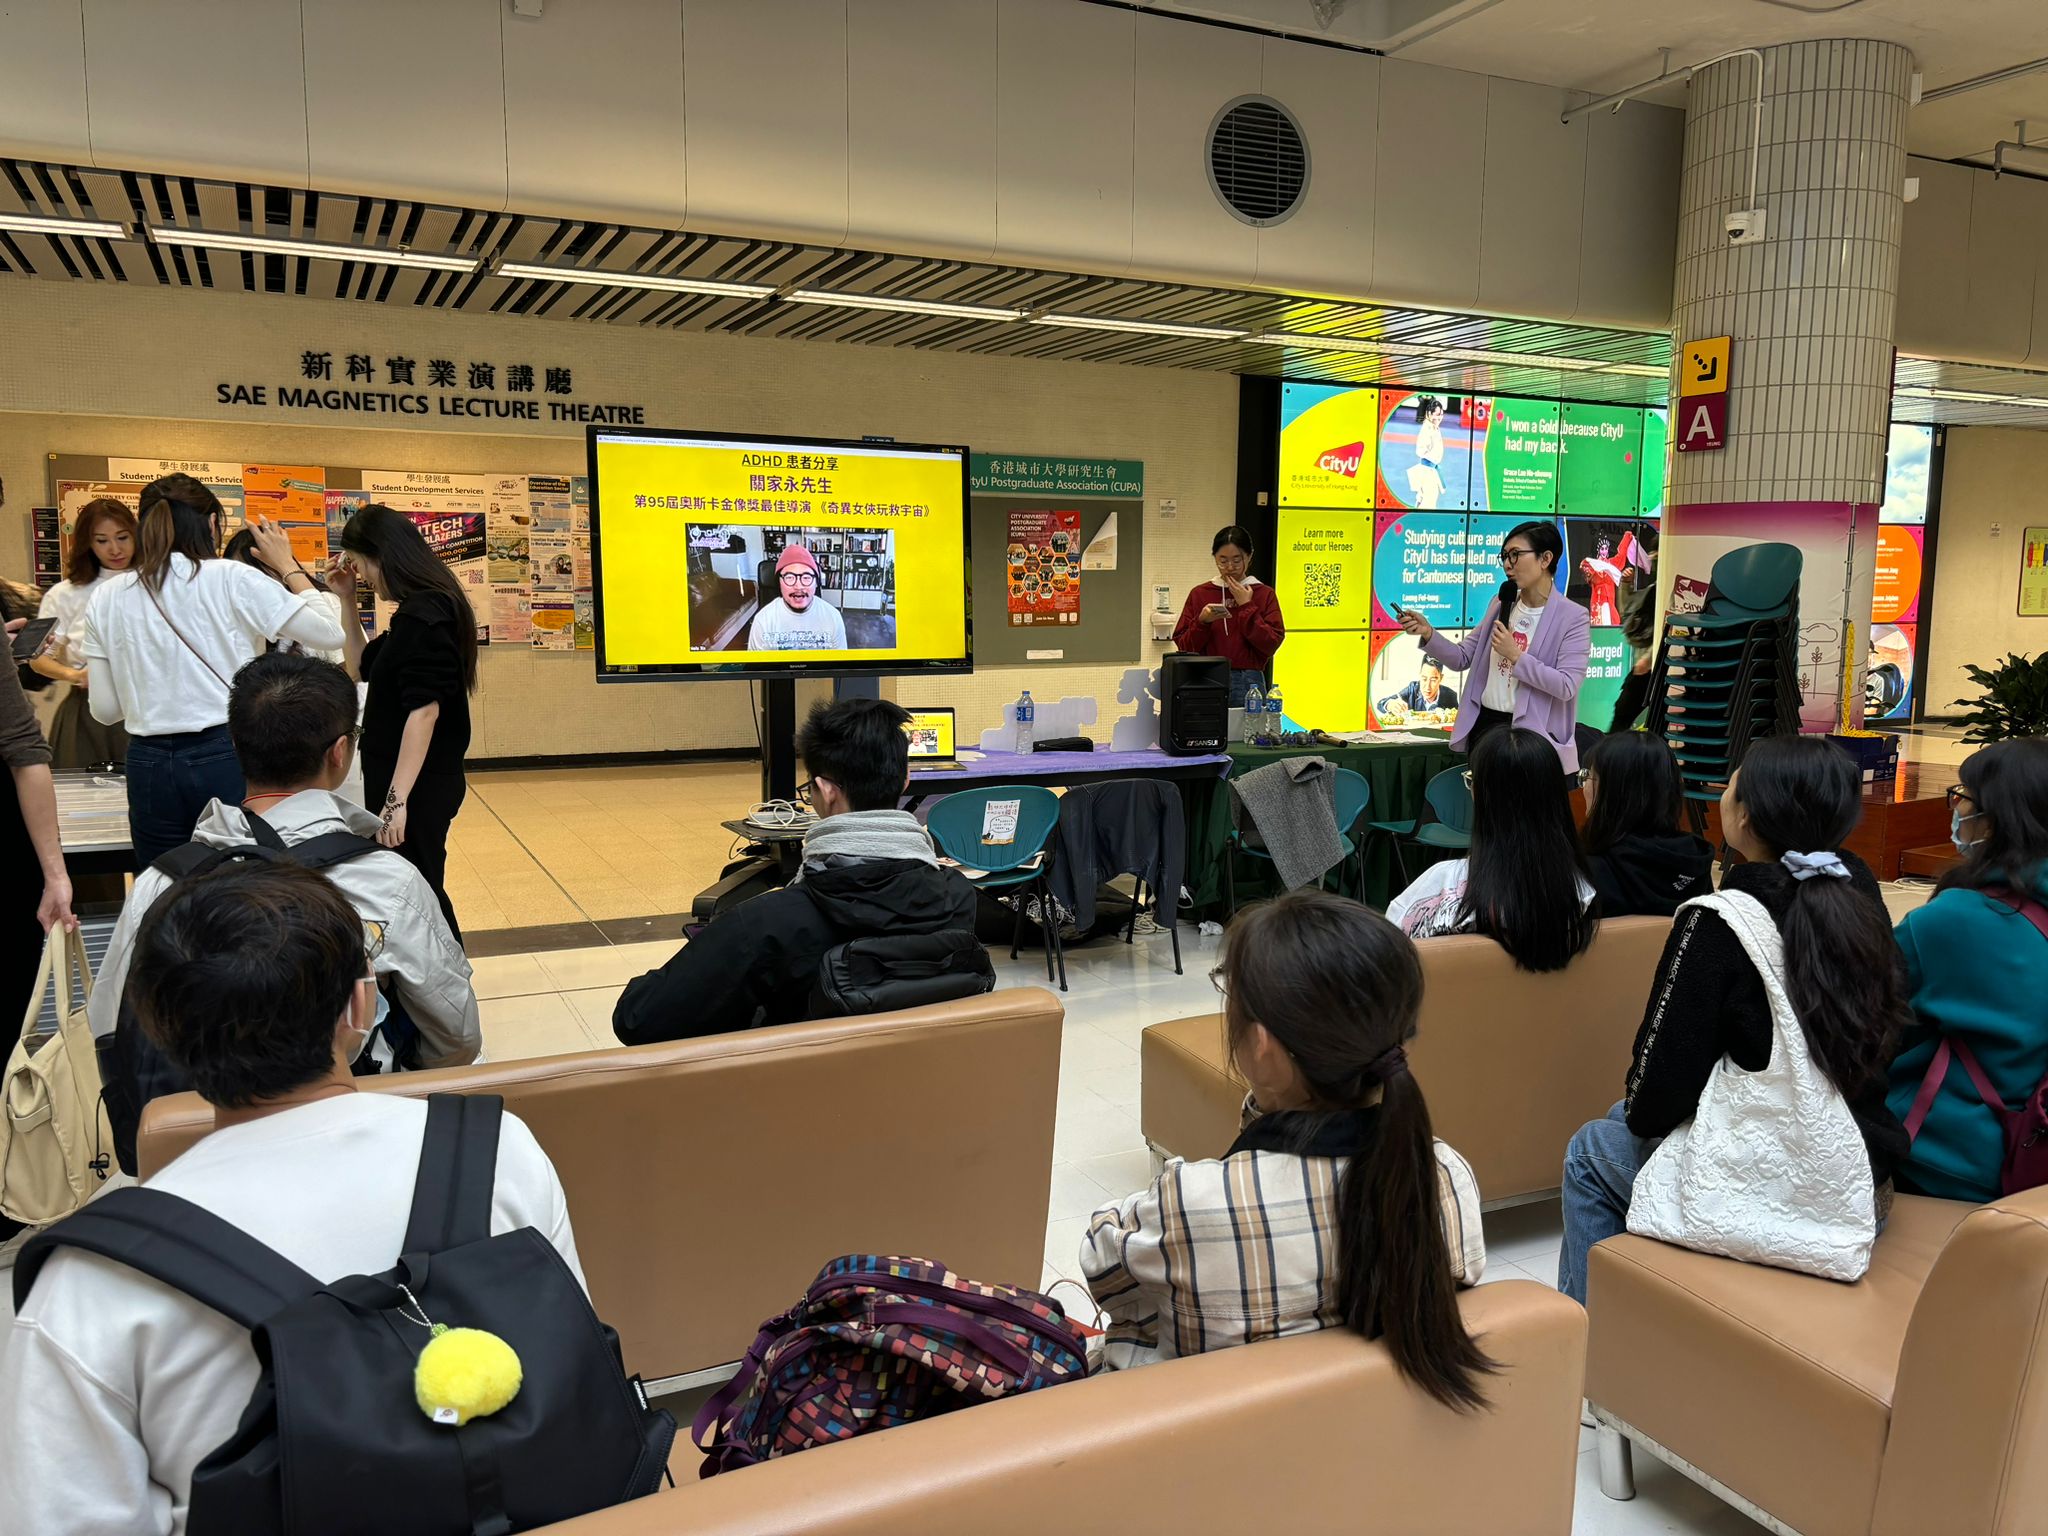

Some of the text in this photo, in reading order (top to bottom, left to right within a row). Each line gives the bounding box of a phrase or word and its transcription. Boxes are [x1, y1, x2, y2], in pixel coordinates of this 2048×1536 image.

[301, 351, 573, 395] 新科實業演講廳
[216, 383, 645, 425] SAE MAGNETICS LECTURE THEATRE
[1505, 416, 1510, 432] I
[1511, 421, 1530, 433] won
[1532, 423, 1537, 433] a
[1600, 423, 1624, 442] CityU
[1686, 405, 1716, 442] A
[1504, 436, 1569, 456] had my back.
[159, 461, 210, 472] 學生發展處
[741, 454, 839, 471] ADHD 患者分享
[990, 460, 1118, 479] 香港城市大學研究生會
[1319, 455, 1360, 476] CityU
[120, 472, 155, 481] Student
[749, 474, 833, 494] 關家永先生
[991, 477, 1054, 490] Postgraduate
[1056, 481, 1109, 492] Association
[1110, 482, 1142, 494] (CUPA)
[371, 484, 402, 493] Student
[403, 486, 453, 495] Development
[1303, 527, 1344, 538] Learn more
[1404, 529, 1504, 549] Studying culture and
[1292, 540, 1354, 552] about our Heroes
[1403, 549, 1430, 568] CityU
[1430, 549, 1448, 565] has
[1450, 550, 1486, 565] fuelled
[1402, 568, 1496, 587] for Cantonese Opera.
[1604, 662, 1622, 678] and
[1194, 739, 1219, 747] SANSUI
